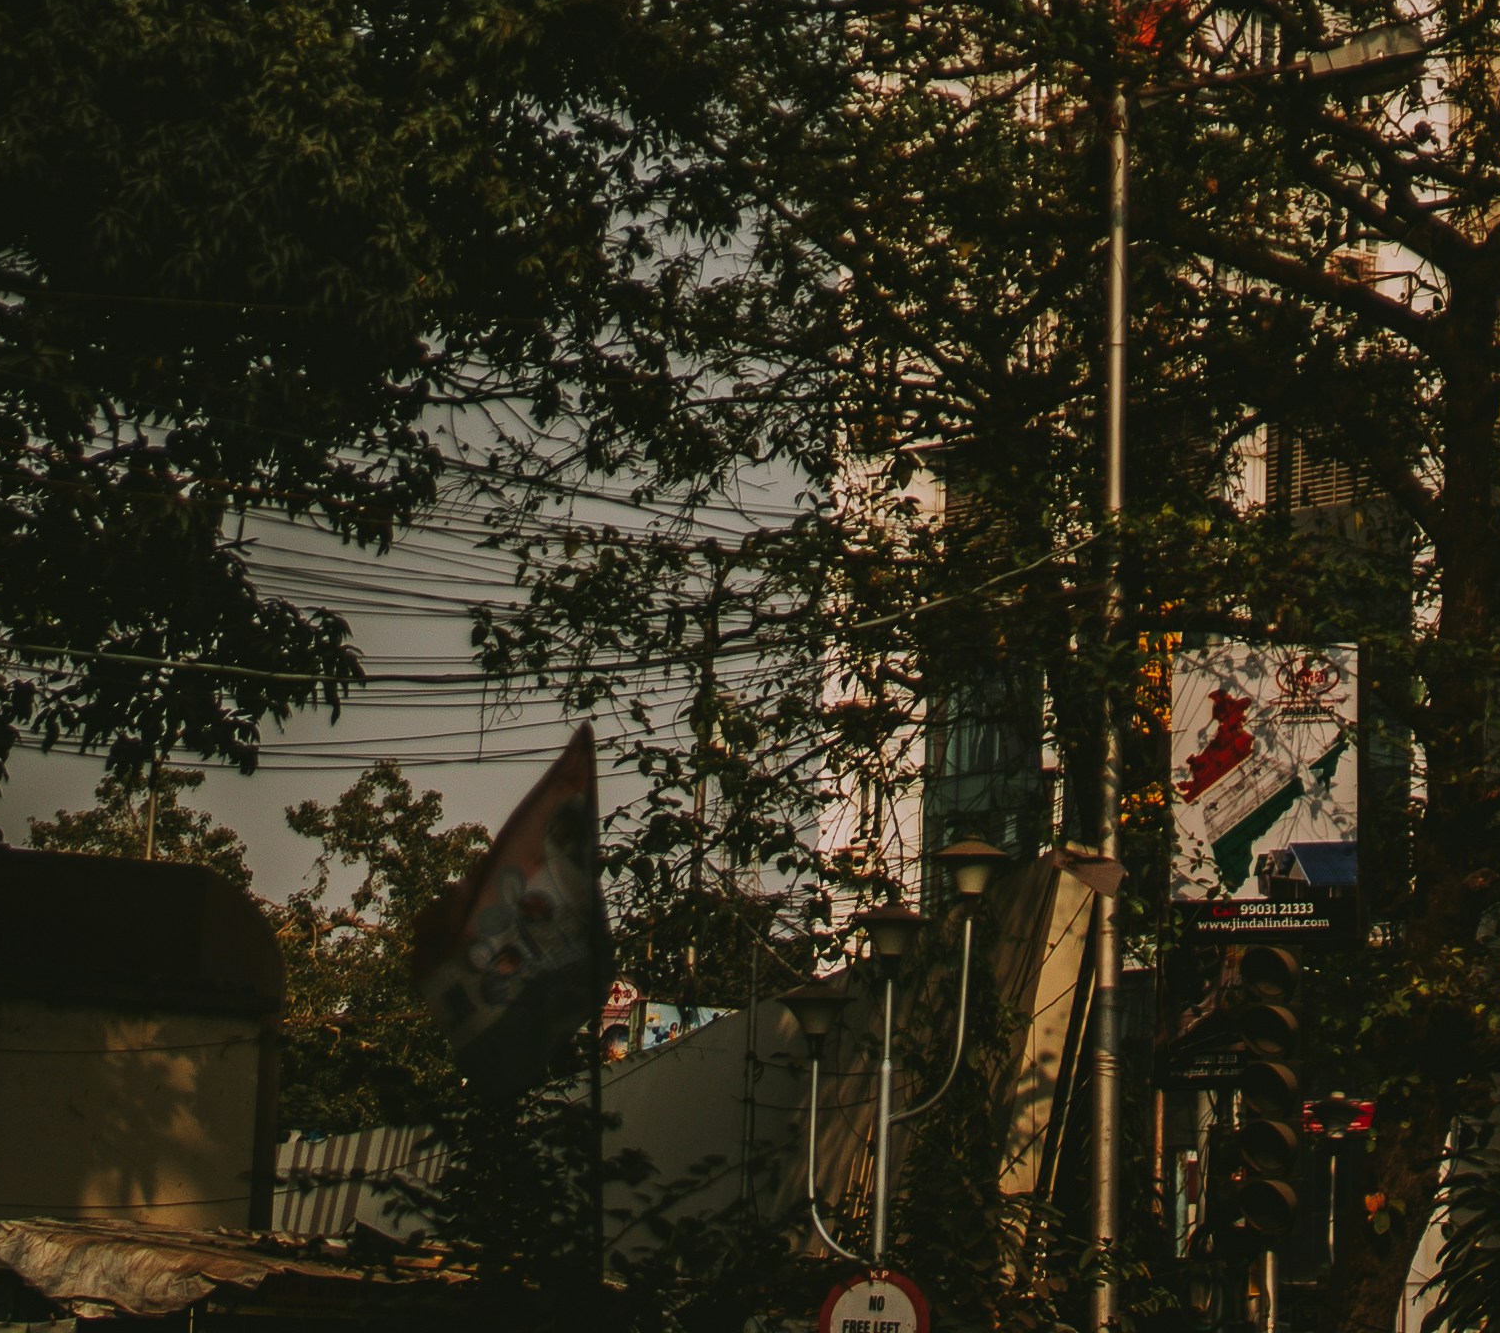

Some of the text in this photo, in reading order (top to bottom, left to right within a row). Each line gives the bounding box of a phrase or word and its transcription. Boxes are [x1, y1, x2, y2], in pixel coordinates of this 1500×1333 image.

[1240, 903, 1277, 915] 99031
[1280, 902, 1314, 914] 21333
[1197, 917, 1330, 931] www.jindalindia.com
[869, 1295, 885, 1311] NO
[842, 1319, 900, 1333] FREE LEFT
